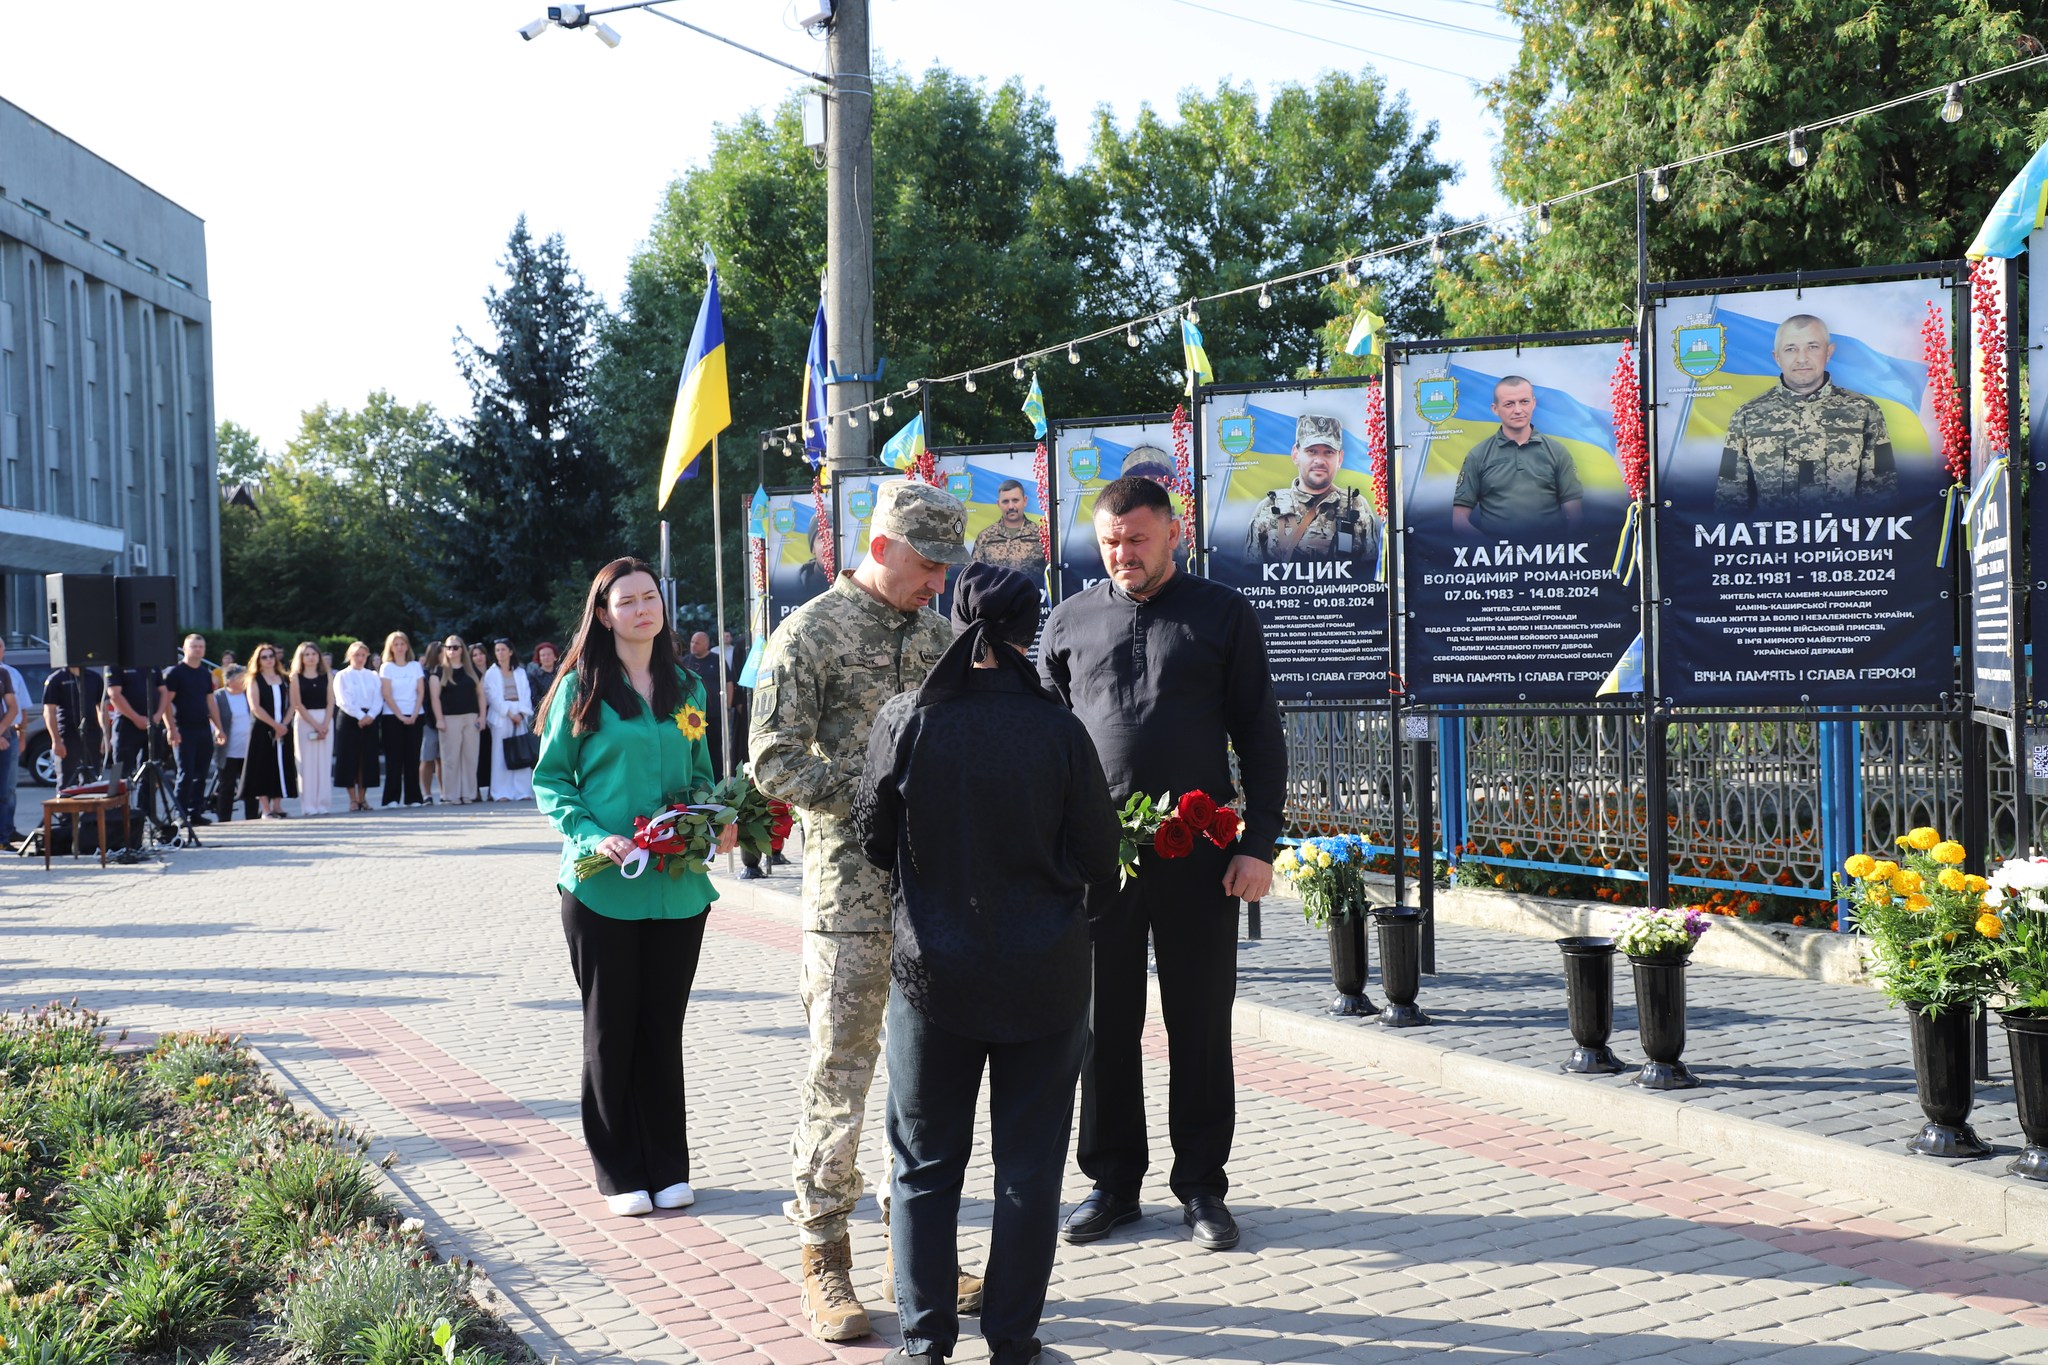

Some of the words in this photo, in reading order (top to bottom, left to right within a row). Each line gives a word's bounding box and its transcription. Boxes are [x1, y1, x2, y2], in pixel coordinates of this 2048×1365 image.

[1695, 512, 1913, 547] МАТВІЙЧУК
[1453, 540, 1588, 567] ХАЙМИК
[1714, 552, 1787, 566] РУСЛАН
[1794, 547, 1893, 563] ЮРІЙОВИЧ
[1263, 560, 1353, 583] КУЦИК
[1424, 572, 1518, 585] ВОЛОДИМИР
[1712, 572, 1790, 586] 28.02.1981
[1810, 569, 1896, 583] 18.08.2024
[1237, 586, 1276, 596] АСИЛЬ
[1444, 589, 1514, 601] 07.06.1983
[1530, 587, 1599, 599] 14.08.2024
[1784, 589, 1888, 598] КАМЕНЯ-КАШИРСЬКОГО
[1249, 599, 1300, 609] 7.04.1982
[1313, 597, 1375, 607] 09.08.2024
[1735, 601, 1827, 611] КАМІНЬ-КАШИРСЬКОЇ
[1829, 601, 1872, 609] ГРОМАДИ
[1466, 614, 1541, 622] КАМІНЬ-КАШИРСЬКОЇ
[1874, 610, 1915, 619] УКРАЇНИ,
[1793, 624, 1844, 632] ВІЙСЬКОВІЙ
[1753, 647, 1809, 656] УКРАЇНСЬКОЇ
[1811, 647, 1854, 655] ДЕРЖАВИ
[1271, 673, 1304, 682] АМ'ЯТЬ
[1312, 672, 1345, 681] СЛАВА
[1348, 671, 1386, 681] ГЕРОЮ!
[1432, 673, 1464, 682] ВІЧНА
[1467, 672, 1516, 682] ПАМ'ЯТЬ
[1519, 672, 1522, 682] І
[1525, 671, 1564, 681] СЛАВА
[1567, 671, 1610, 681] ГЕРОЮ
[1694, 671, 1732, 682] ВІЧНА
[1736, 670, 1796, 681] ПАМ'ЯТЬ
[1799, 669, 1803, 681] І
[1807, 669, 1855, 681] СЛАВА
[1859, 667, 1916, 680] ГЕРОЮ!
